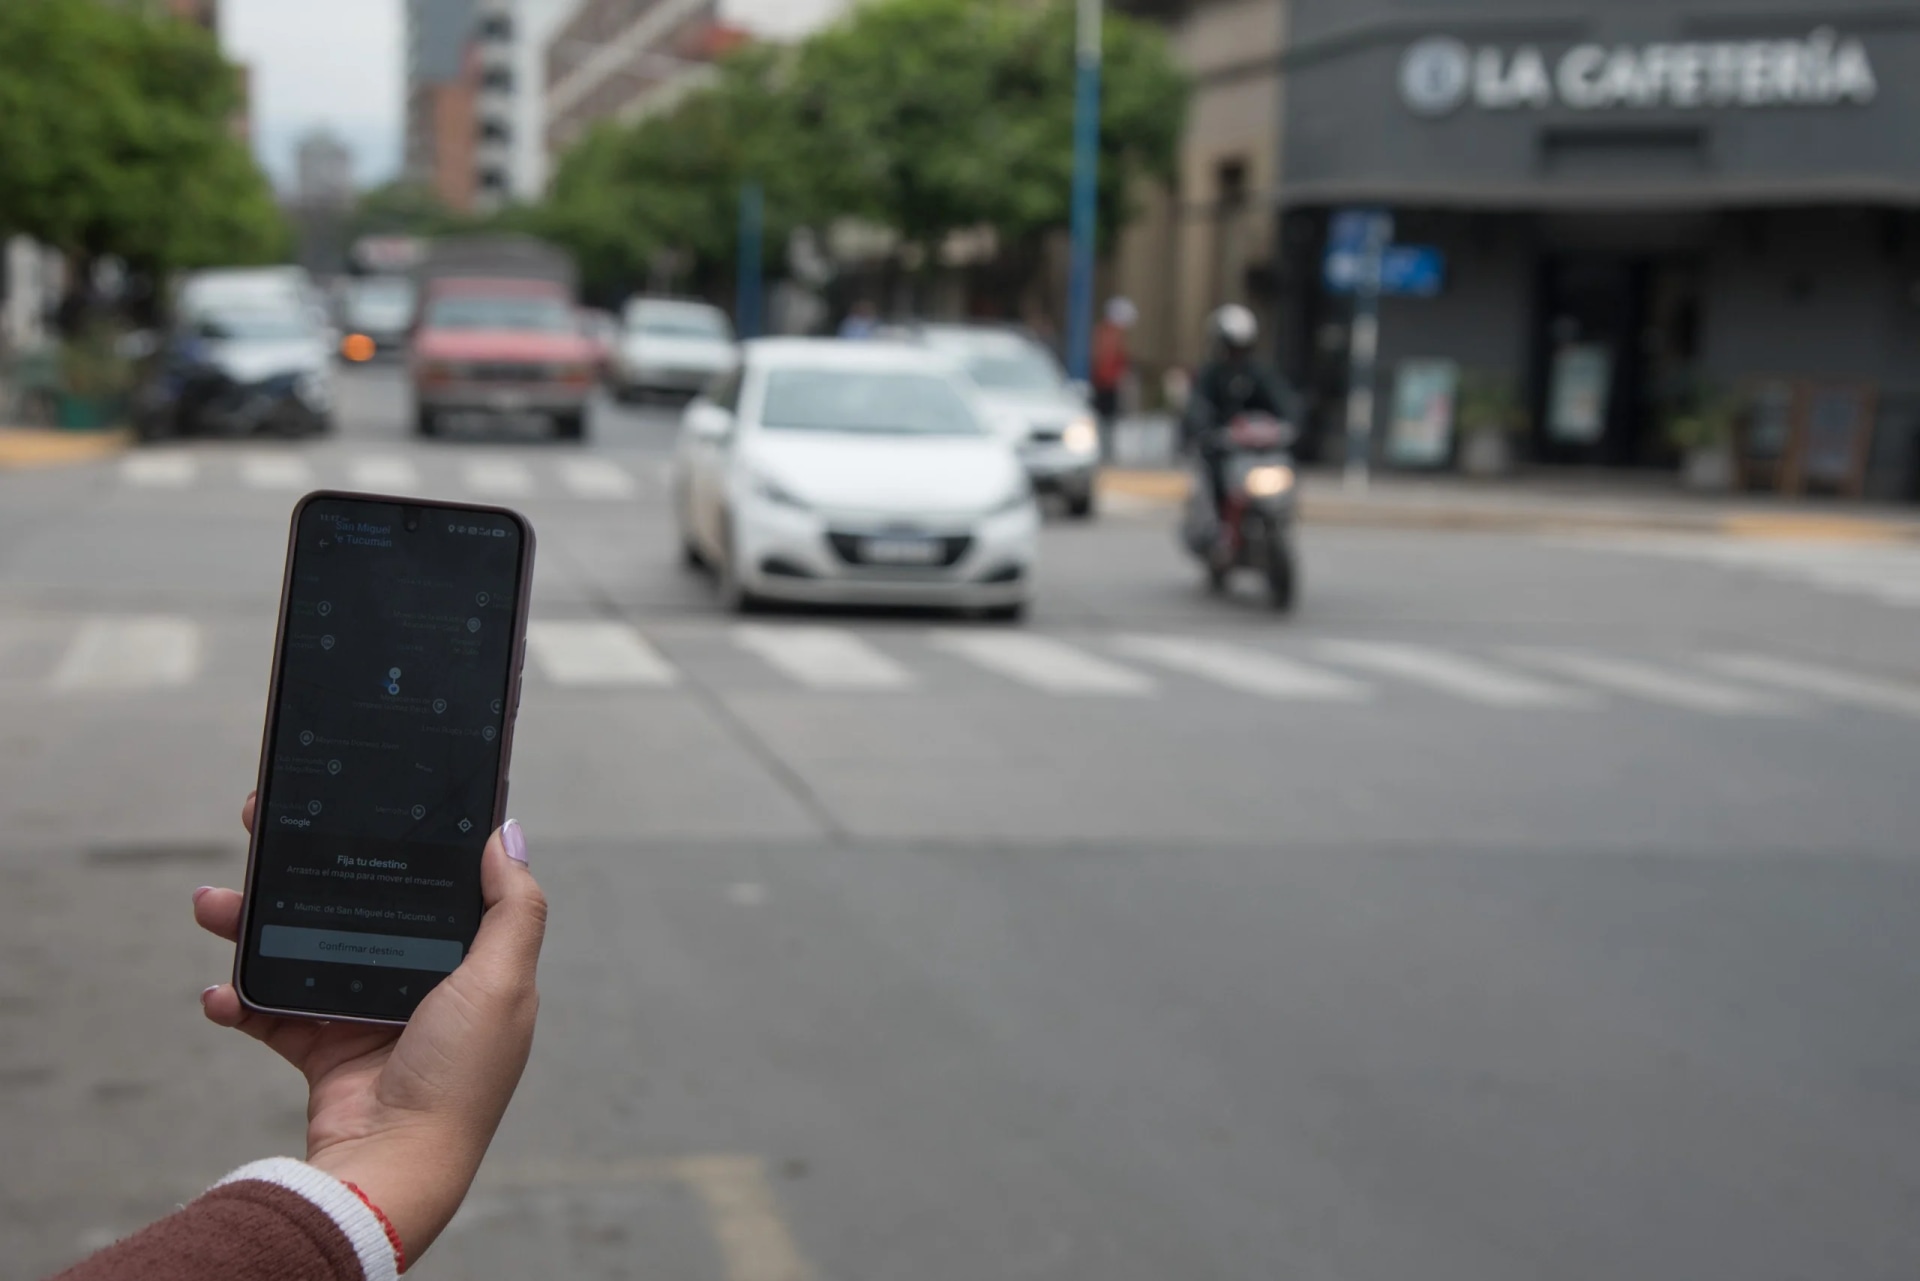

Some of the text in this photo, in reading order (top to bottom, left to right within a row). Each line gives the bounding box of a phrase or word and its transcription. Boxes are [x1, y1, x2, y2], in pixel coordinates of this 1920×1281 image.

[1472, 26, 1876, 107] LA CAFETERÍA
[336, 521, 391, 535] San Miguel
[346, 534, 392, 548] Tucumán
[280, 815, 311, 828] Google
[337, 855, 408, 870] Fija tu destino
[286, 865, 321, 877] Arrastra
[322, 868, 330, 876] el
[331, 870, 355, 880] mapa
[356, 872, 376, 882] para
[376, 874, 403, 884] mover
[405, 875, 413, 884] el
[324, 904, 335, 914] de
[336, 905, 353, 915] San
[353, 907, 384, 920] Miguel
[384, 909, 396, 919] de
[397, 911, 437, 922] Tucumán
[318, 941, 405, 957] Confirmar destino
